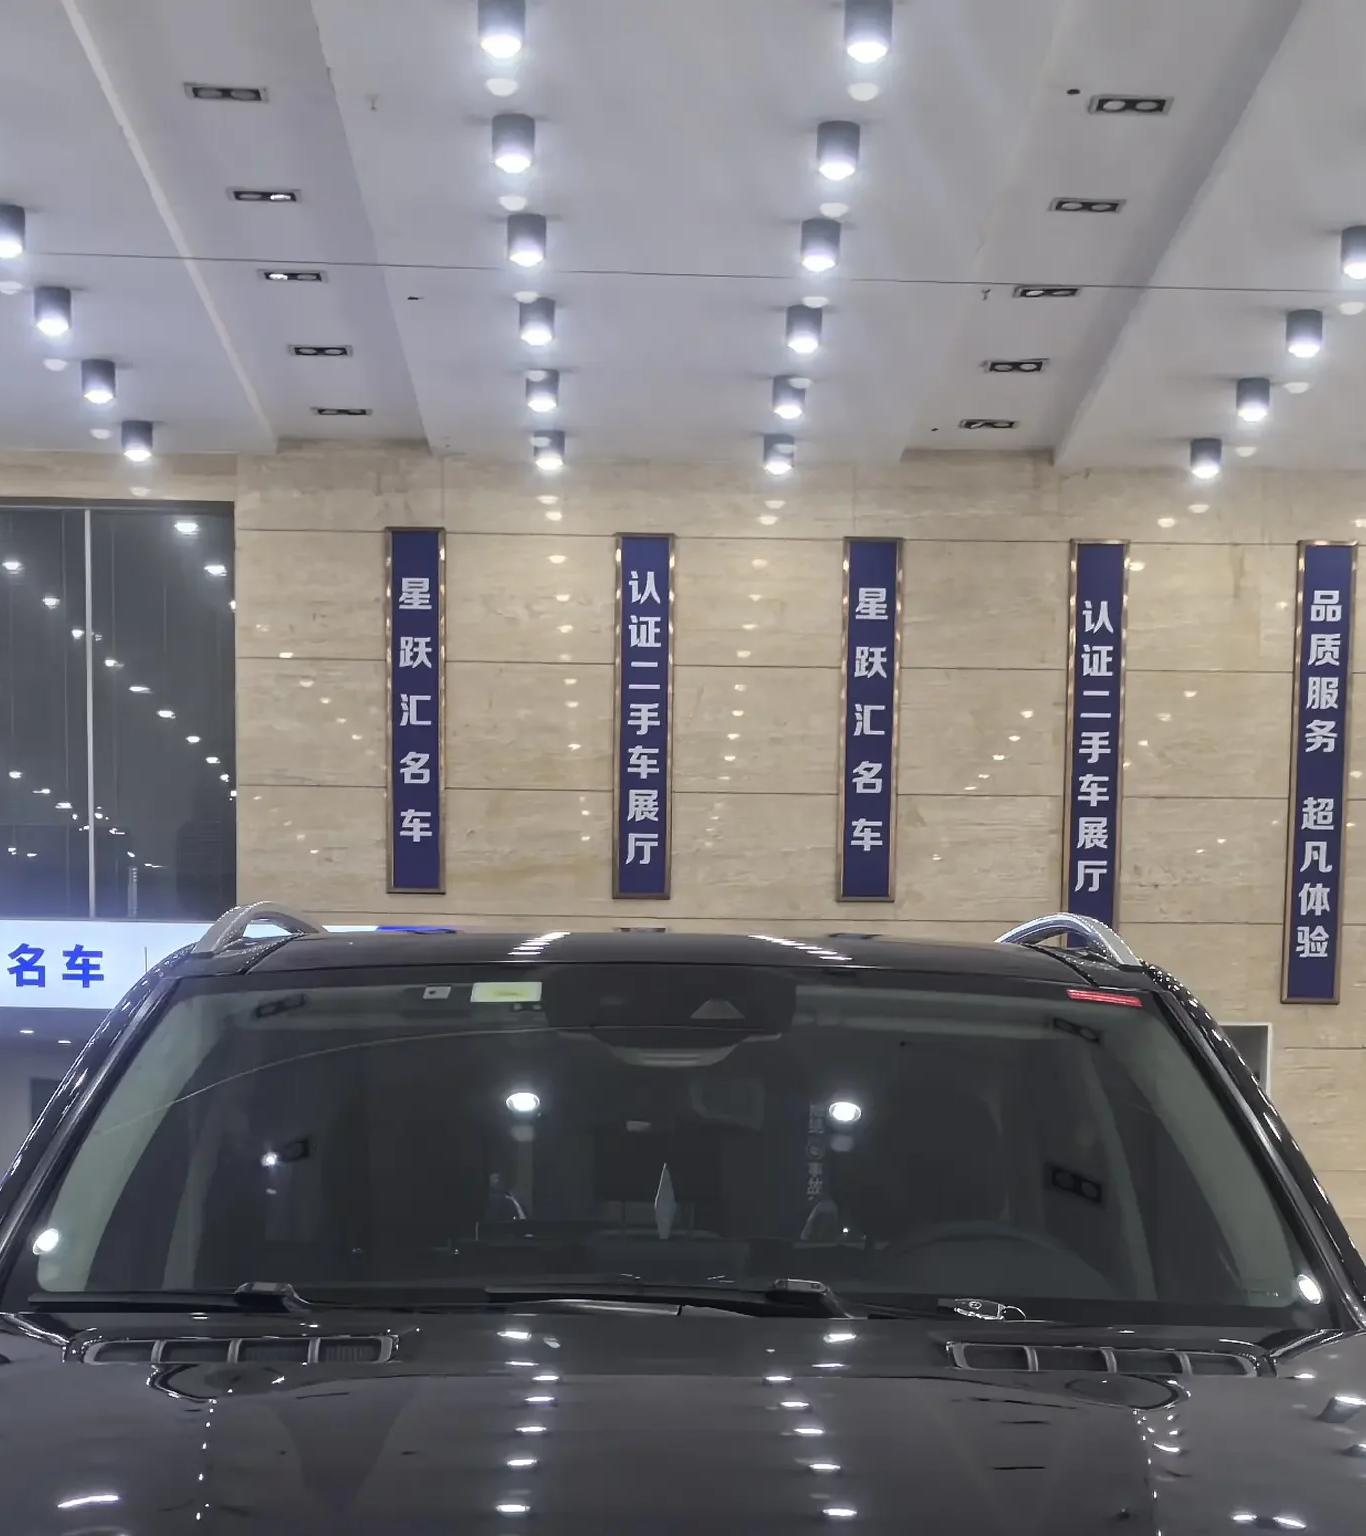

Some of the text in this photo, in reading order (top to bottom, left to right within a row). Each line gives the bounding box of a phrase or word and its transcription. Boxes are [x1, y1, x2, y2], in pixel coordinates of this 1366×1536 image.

[398, 577, 433, 843] 星跃汇名车
[625, 570, 662, 865] 认证二手车展厅
[851, 587, 888, 852] 星跃汇名车
[1074, 599, 1115, 893] 认证二手车展厅
[1296, 589, 1342, 958] 品质服务 超凡体验
